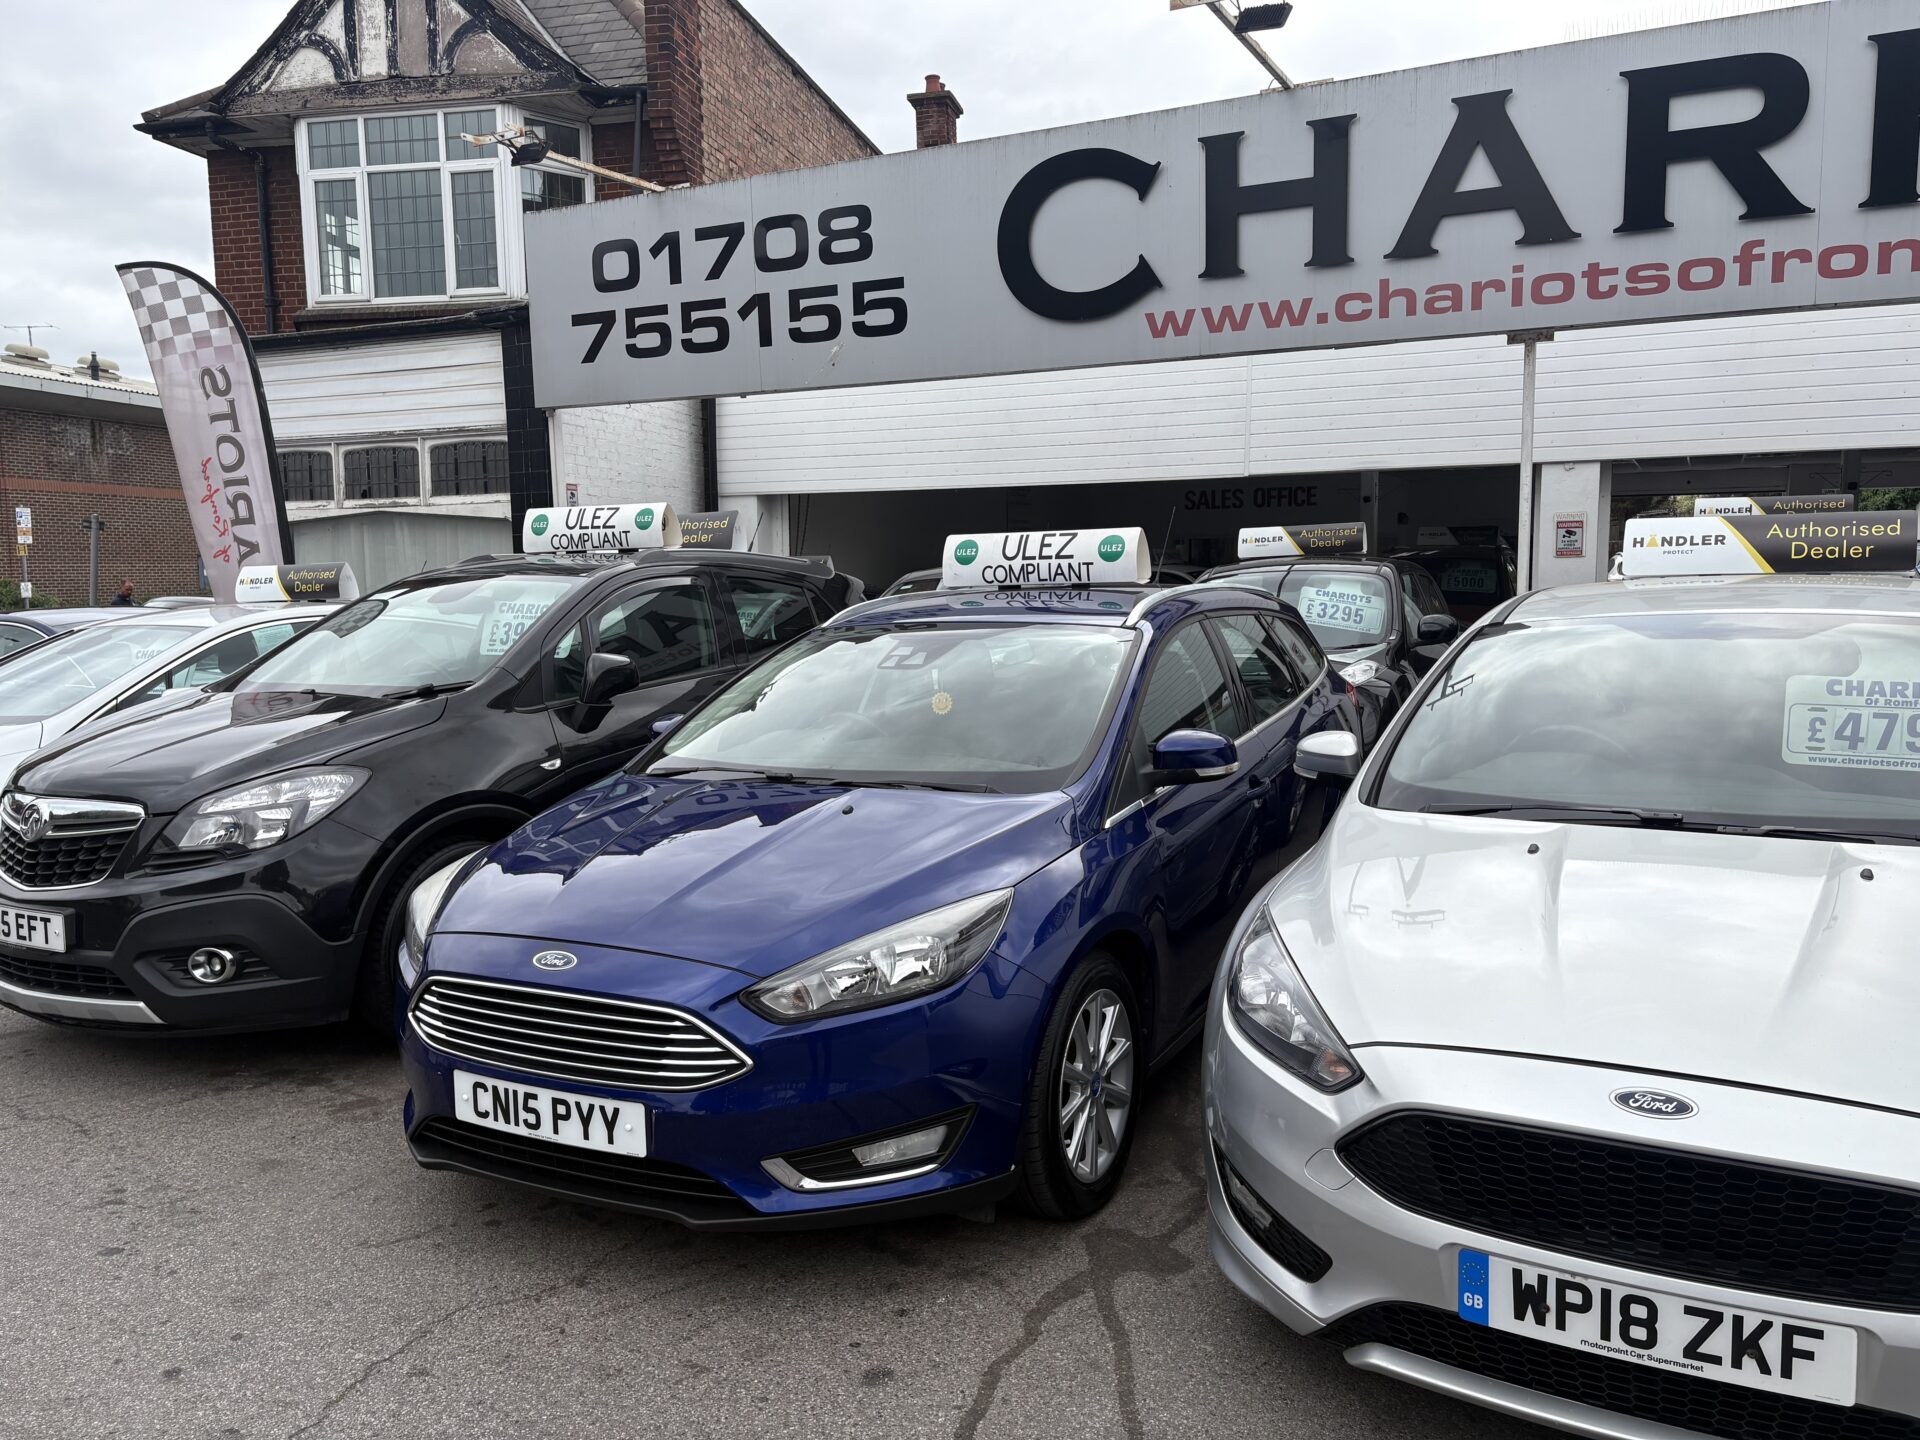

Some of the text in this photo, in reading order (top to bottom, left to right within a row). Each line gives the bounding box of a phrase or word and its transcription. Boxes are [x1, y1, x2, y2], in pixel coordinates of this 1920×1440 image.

[997, 28, 1920, 322] CHARI
[592, 204, 873, 293] 01708
[571, 277, 908, 364] 755155
[1184, 486, 1319, 511] SALES OFFICE
[1773, 499, 1846, 510] Authorised
[565, 507, 620, 530] ULEZ
[637, 514, 653, 522] ULEZ
[1300, 526, 1358, 538] Authorised
[1766, 518, 1902, 539] Authorised
[550, 531, 631, 550] COMPLIANT
[1001, 532, 1079, 562] ULEZ
[1100, 544, 1123, 553] ULEZ
[1242, 536, 1284, 544] HANDLER
[1310, 538, 1347, 548] Dealer
[1632, 534, 1727, 548] HANDLER
[1791, 540, 1875, 560] Dealer
[956, 547, 977, 556] ULEZ
[287, 568, 337, 581] Authorised
[982, 562, 1094, 584] COMPLIANT
[294, 581, 325, 592] Dealer
[1316, 589, 1373, 604] CHARIOTS
[1305, 602, 1365, 625] £3295
[15, 913, 51, 945] EFT
[540, 953, 567, 967] Ford
[1628, 1092, 1677, 1112] Ford
[472, 1081, 620, 1145] CN15 PYY
[1463, 1292, 1483, 1309] GB
[1512, 1267, 1824, 1381] WP18 ZKF
[1630, 1351, 1647, 1360] Car
[1647, 1353, 1704, 1373] Supermarket
